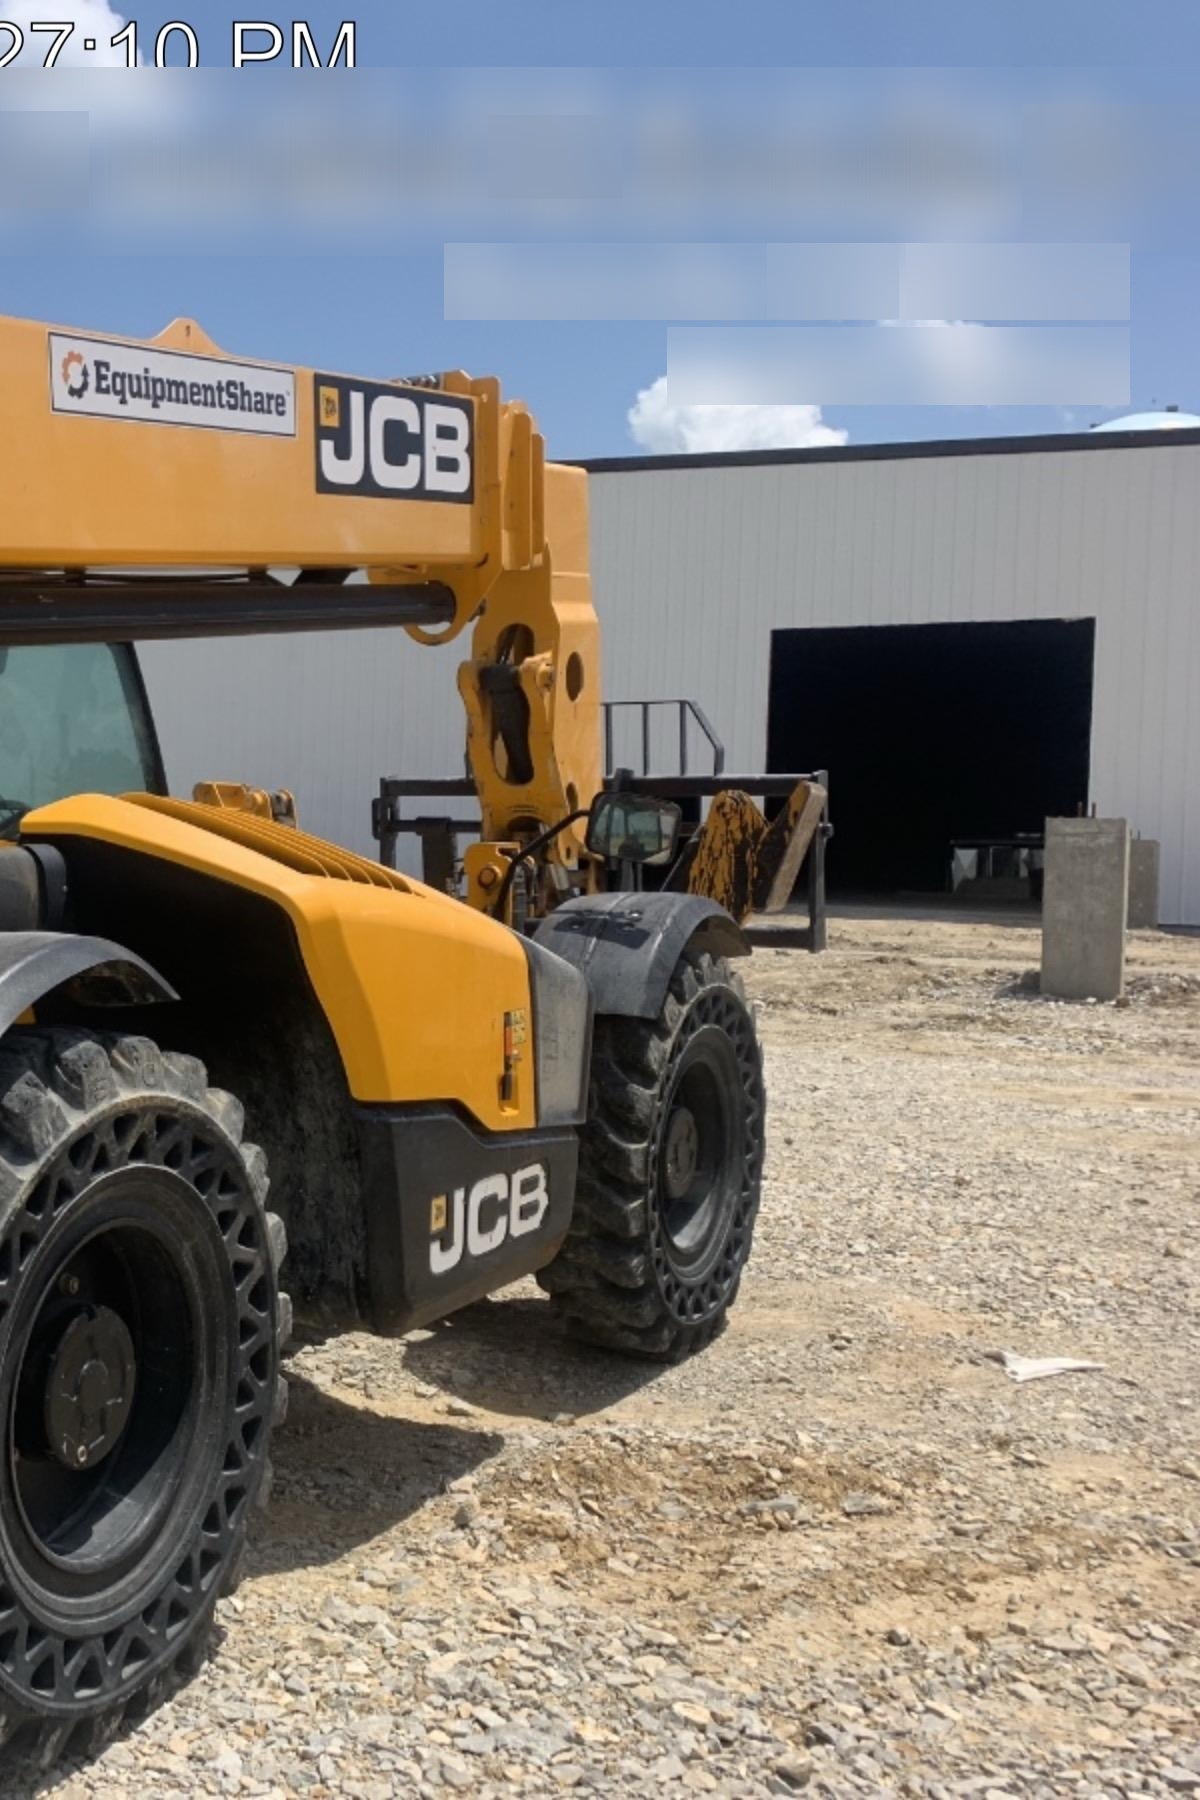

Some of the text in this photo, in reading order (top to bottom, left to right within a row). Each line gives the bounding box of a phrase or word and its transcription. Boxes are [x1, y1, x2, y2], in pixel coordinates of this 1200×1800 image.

[93, 359, 287, 417] EquipmentShare
[319, 390, 472, 494] JCB
[429, 1163, 549, 1275] JCB
